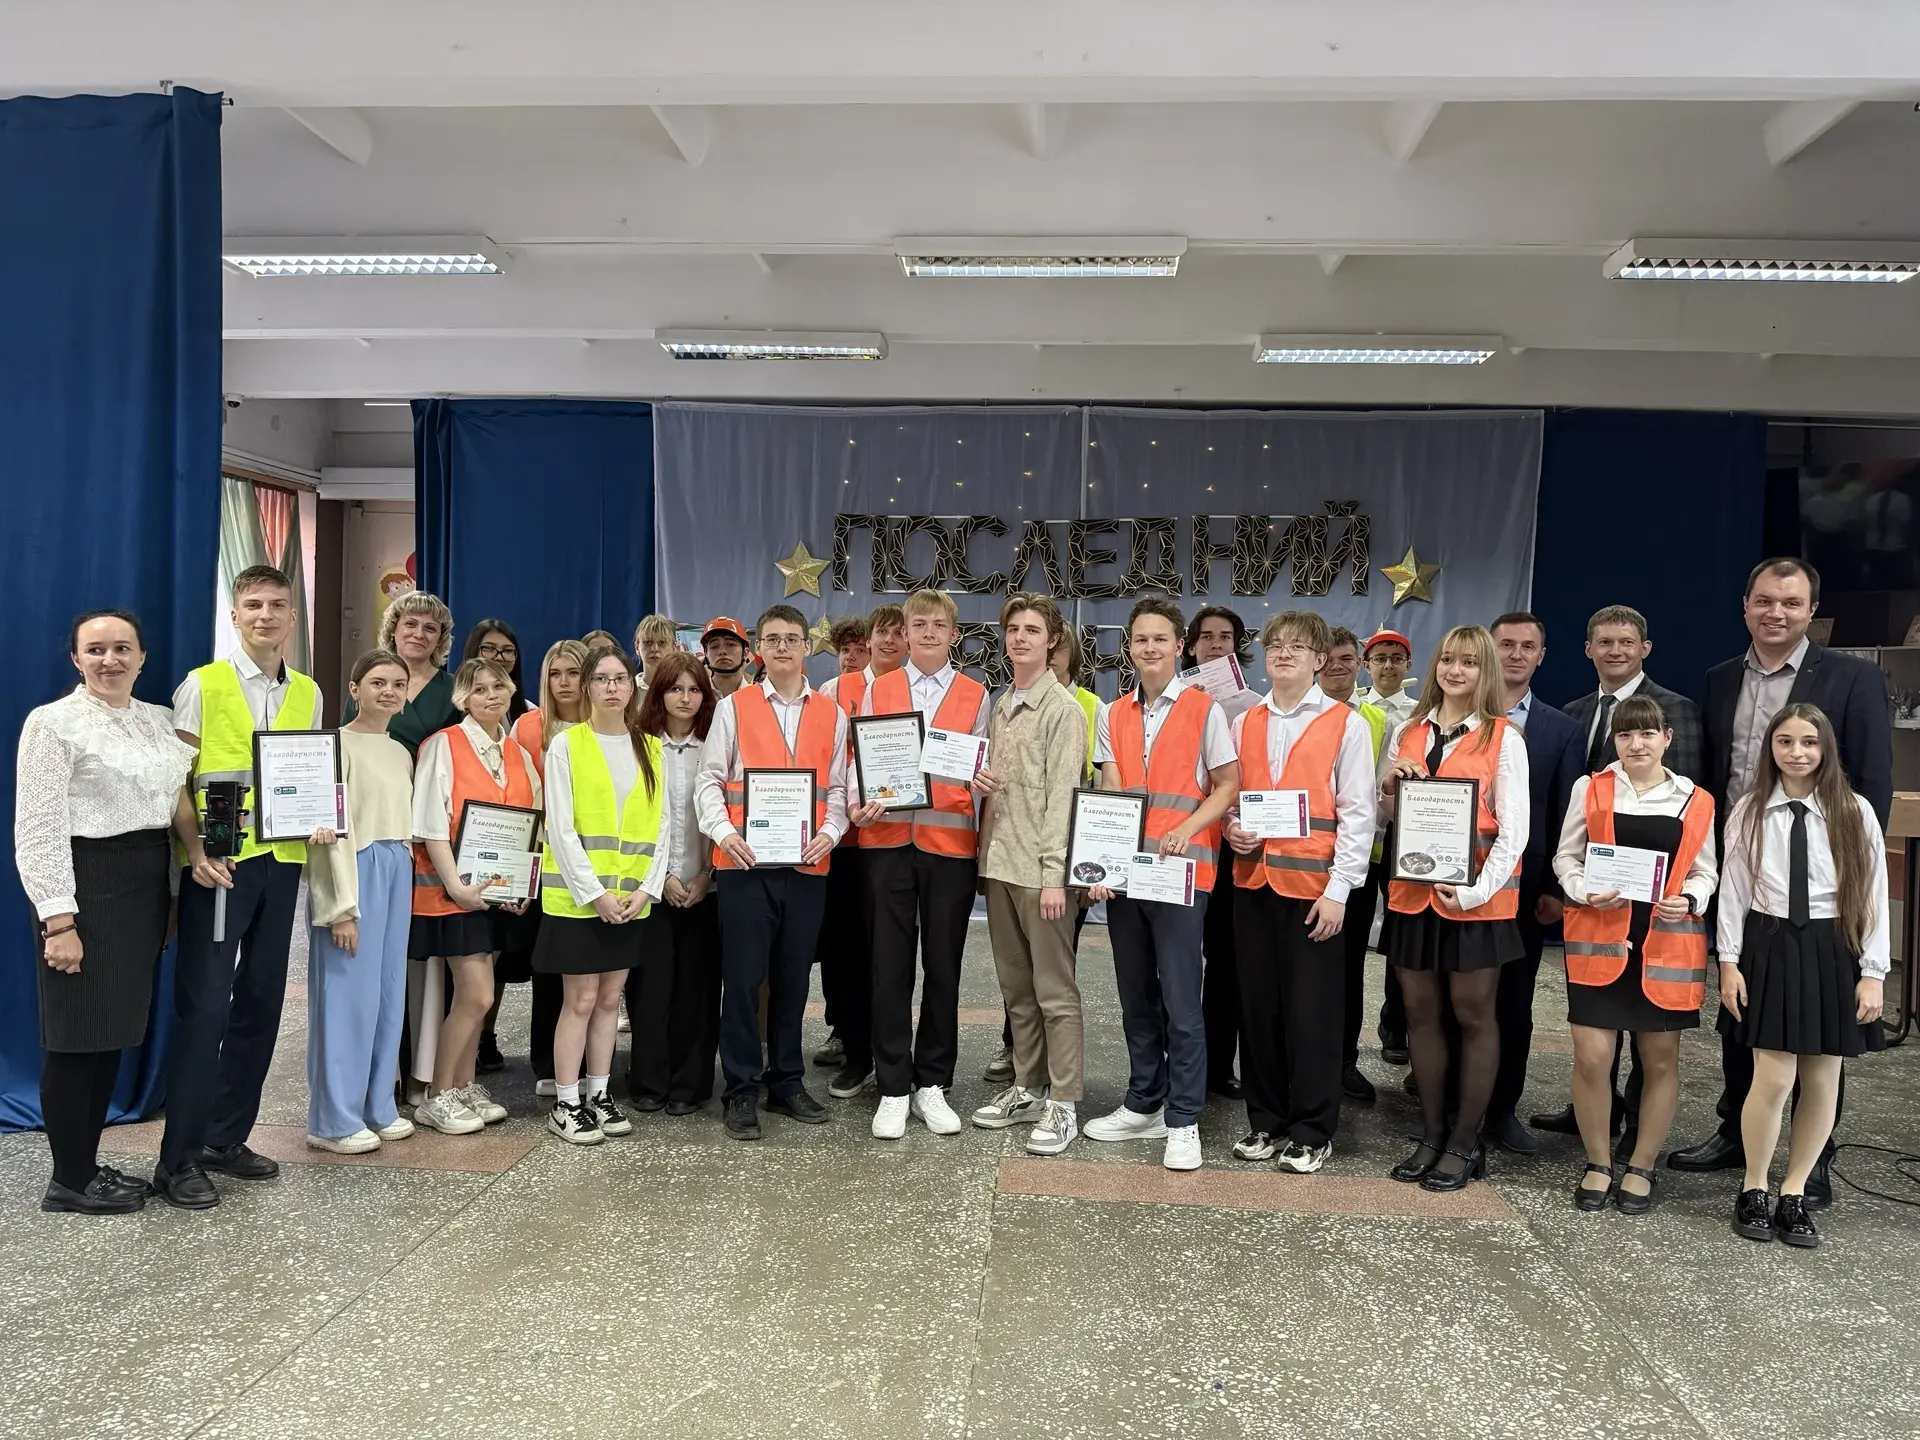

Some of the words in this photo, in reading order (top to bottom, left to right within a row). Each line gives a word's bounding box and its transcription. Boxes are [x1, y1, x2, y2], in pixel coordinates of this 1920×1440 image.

[833, 500, 1370, 598] ПОСЛЕДНИЙ
[863, 730, 915, 741] Благодарность
[267, 751, 328, 759] Благодарность
[755, 786, 806, 795] Благодарность
[1407, 794, 1465, 805] Благодарность
[1083, 806, 1135, 818] Благодарность
[471, 818, 526, 832] Благодарность
